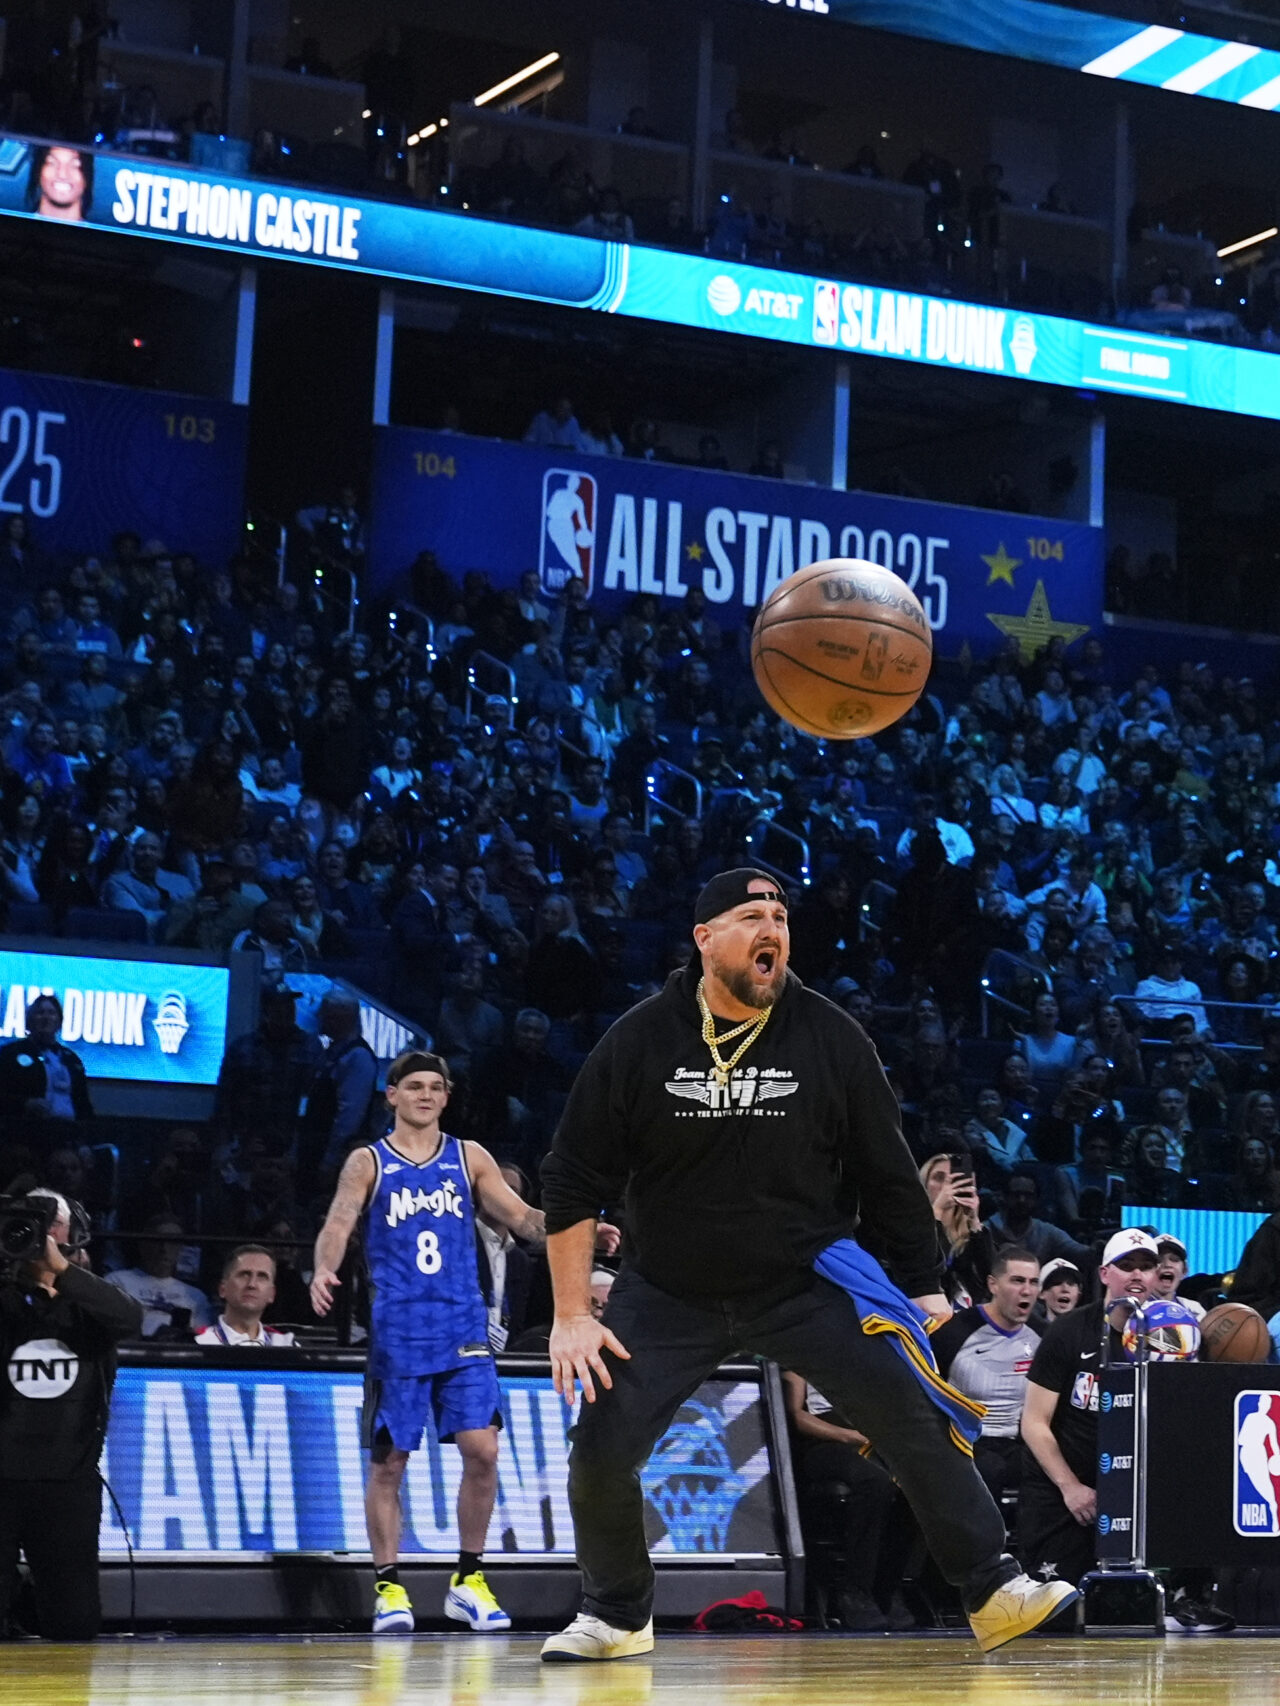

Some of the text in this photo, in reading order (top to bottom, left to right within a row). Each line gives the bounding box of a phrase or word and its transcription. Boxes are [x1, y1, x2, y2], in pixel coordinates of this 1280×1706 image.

[112, 169, 362, 260] STEPHON CASTLE
[744, 288, 803, 320] AT&T
[840, 286, 1006, 370] SLAM DUNK
[165, 413, 215, 443] 103
[413, 451, 456, 479] 104
[604, 494, 689, 598] ALL
[1027, 537, 1064, 562] 104
[61, 988, 147, 1046] DUNK
[674, 1067, 706, 1080] Team
[416, 1230, 442, 1275] 8
[10, 1359, 79, 1381] TNT
[1112, 1394, 1134, 1408] AT&T
[1111, 1455, 1133, 1470] AT&T
[1110, 1517, 1132, 1532] AT&T
[1241, 1503, 1268, 1526] NBA
